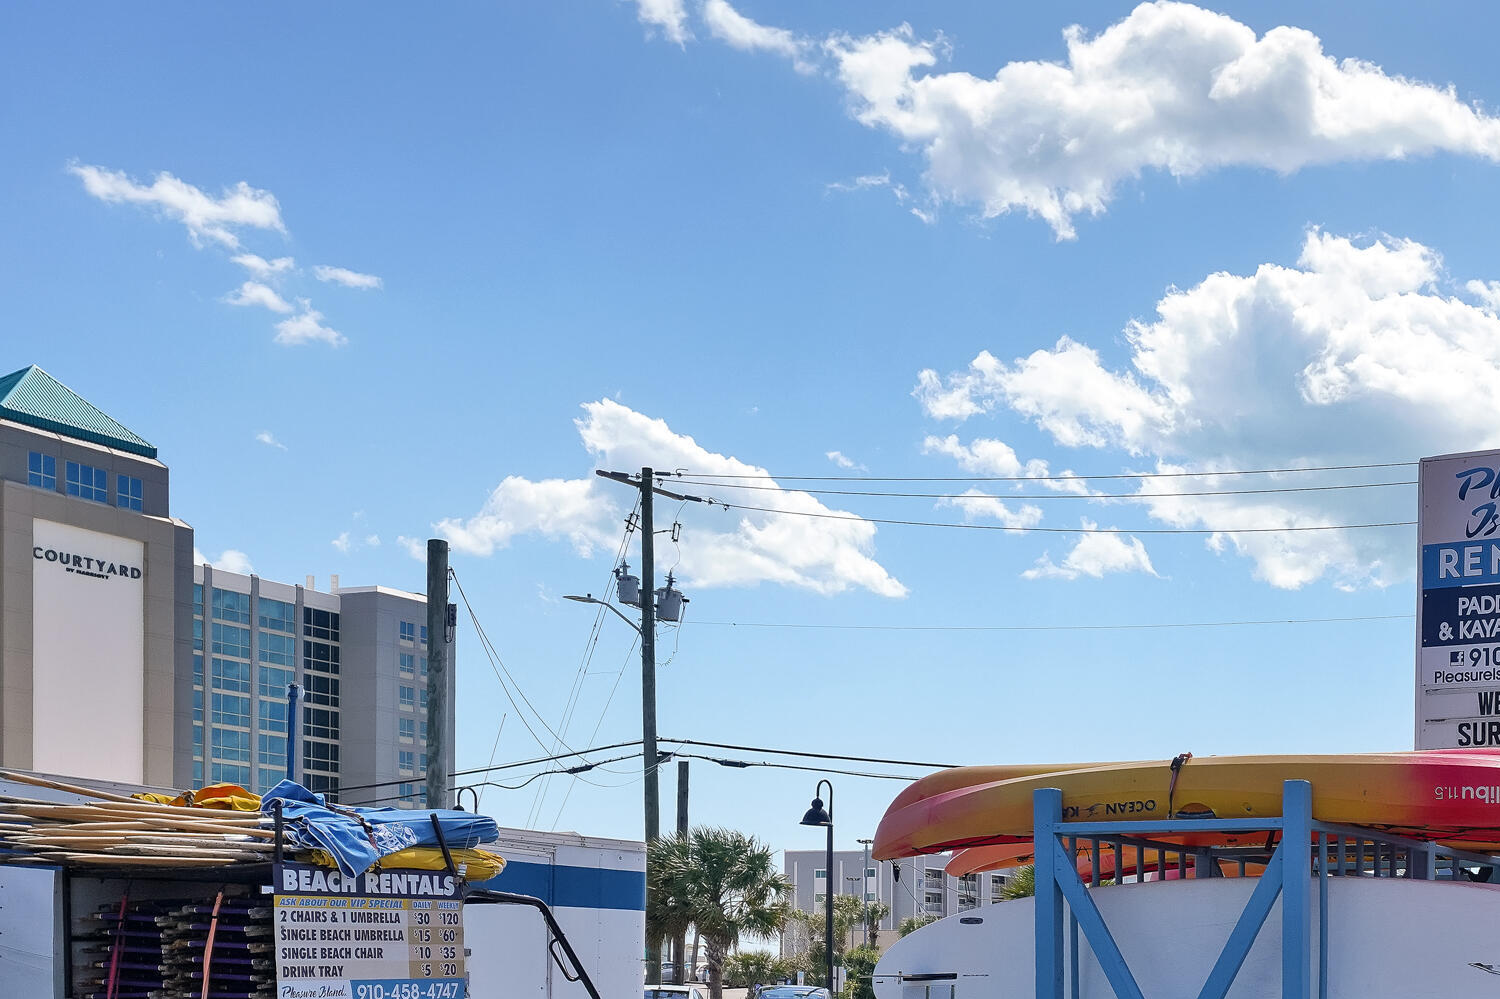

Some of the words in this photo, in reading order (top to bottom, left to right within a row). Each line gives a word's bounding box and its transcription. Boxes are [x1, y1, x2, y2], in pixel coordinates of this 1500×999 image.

[33, 547, 141, 579] COURTYARD
[1439, 621, 1453, 641] &
[1105, 800, 1156, 815] OCEAN
[282, 869, 357, 893] BEACH
[364, 873, 456, 897] RENTALS
[279, 898, 296, 906] ASK
[299, 898, 328, 907] ABOUT
[350, 899, 366, 907] VIP
[368, 900, 403, 909] SPECIAL
[412, 901, 432, 910] DAILY
[438, 901, 459, 910] WEEKLY
[280, 910, 287, 923] 2
[290, 911, 327, 923] CHAIRS
[330, 911, 338, 923] &
[342, 912, 347, 923] 1
[350, 912, 401, 924] UMBRELLA
[413, 912, 430, 925] $30
[438, 912, 459, 925] $120
[281, 929, 317, 941] SINGLE
[320, 929, 351, 941] BEACH
[354, 929, 404, 941] UMBRELLA
[413, 929, 431, 942] $15
[439, 929, 455, 942] $60
[281, 947, 317, 959] SINGLE
[320, 947, 351, 959] BEACH
[354, 947, 383, 959] CHAIR
[414, 947, 431, 959] $10
[439, 947, 456, 959] $35
[282, 965, 315, 977] DRINK
[318, 965, 344, 977] TRAY
[421, 963, 432, 976] $5
[439, 963, 457, 976] $20
[282, 986, 317, 999] Pleasure
[319, 985, 346, 998] Island
